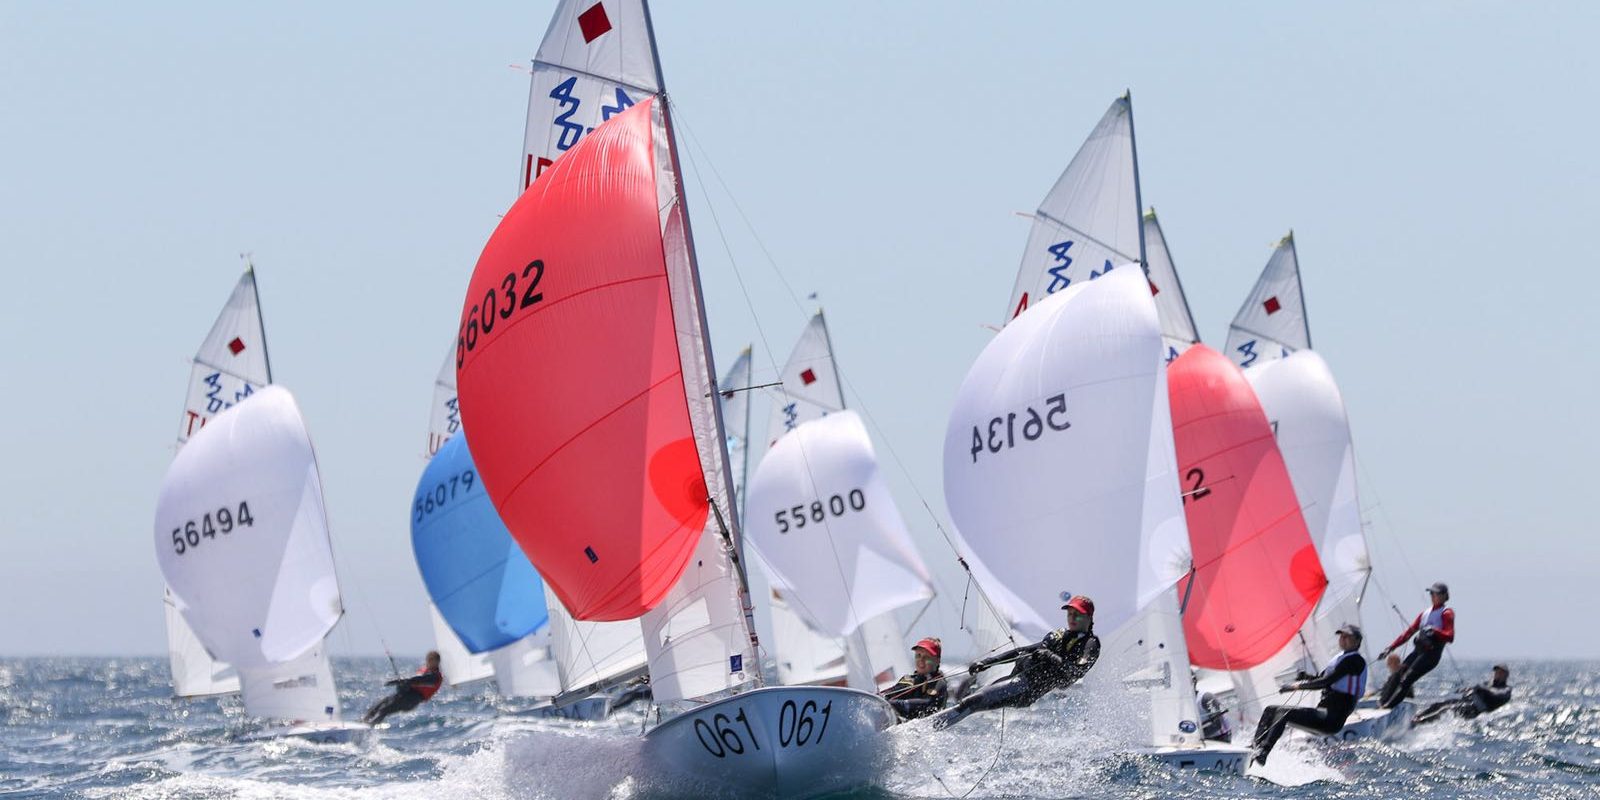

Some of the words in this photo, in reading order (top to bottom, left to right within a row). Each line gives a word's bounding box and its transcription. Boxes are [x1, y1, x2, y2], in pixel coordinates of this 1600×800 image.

[549, 76, 583, 151] 420
[1047, 240, 1074, 294] 420
[1237, 340, 1257, 368] 42
[203, 372, 223, 413] 420
[445, 398, 460, 433] 420
[429, 432, 450, 456] U
[416, 470, 475, 523] 56079
[1182, 468, 1211, 506] 2
[172, 500, 254, 555] 56494
[775, 489, 865, 534] 55800
[694, 707, 760, 758] 061
[779, 700, 832, 748] 061
